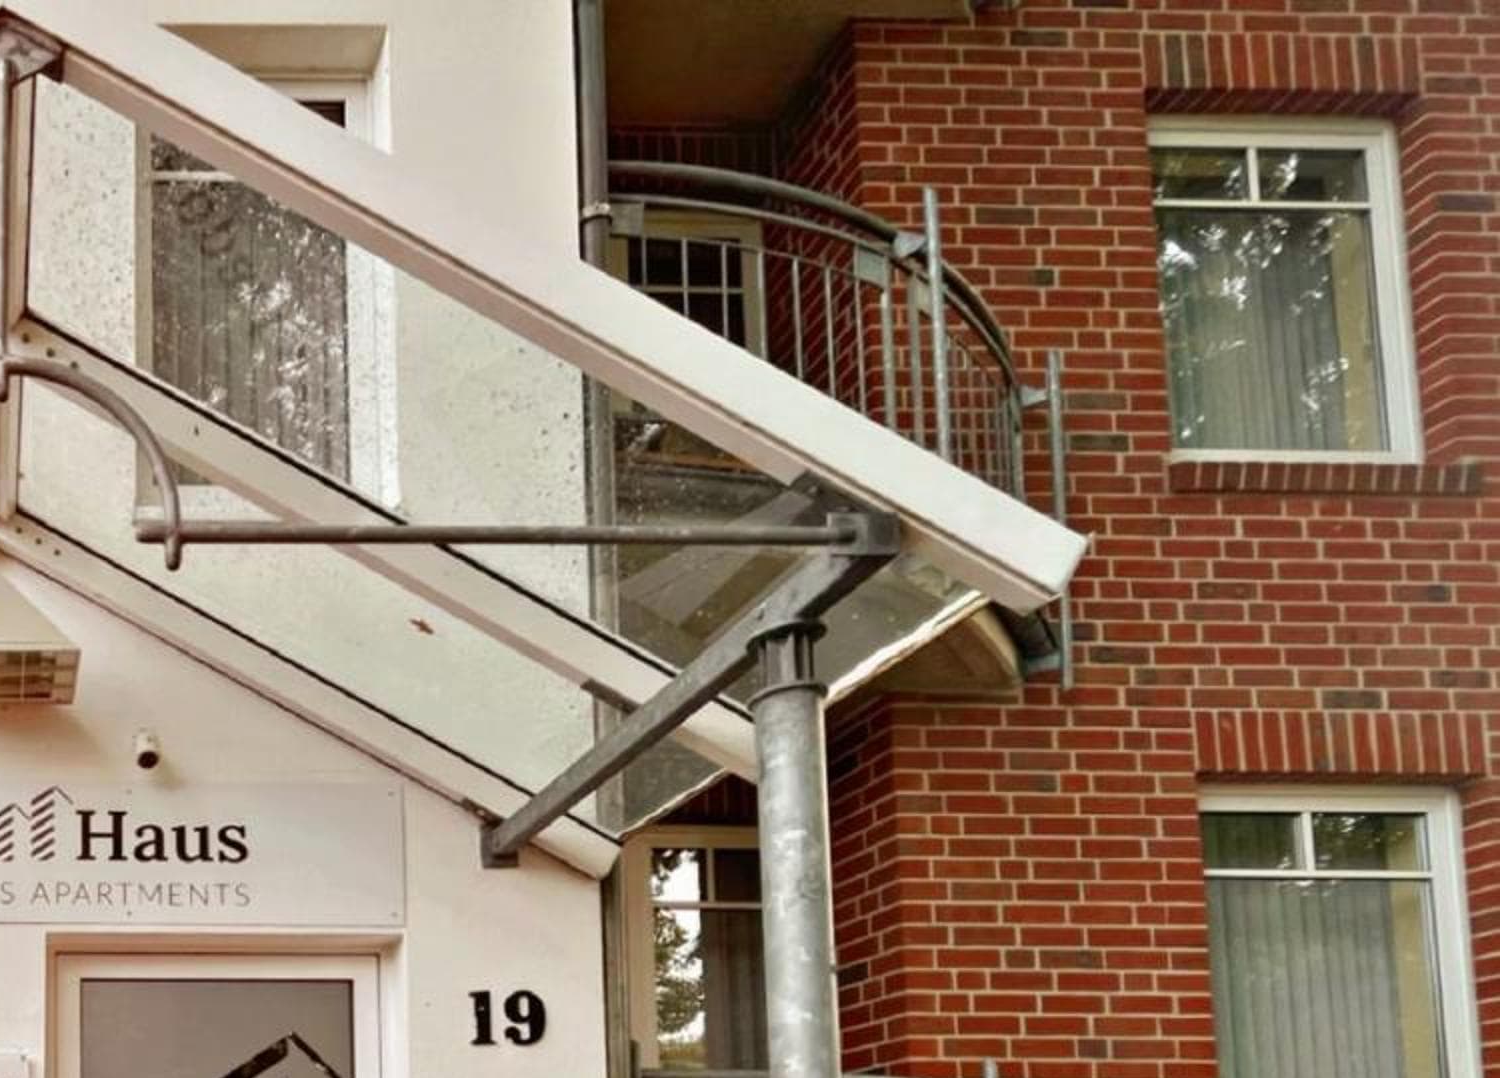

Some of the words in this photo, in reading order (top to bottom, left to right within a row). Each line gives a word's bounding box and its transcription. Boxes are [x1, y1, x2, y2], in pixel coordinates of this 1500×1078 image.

[75, 810, 249, 863] Haus
[30, 881, 251, 907] APARTMENTS
[468, 989, 547, 1046] 19
